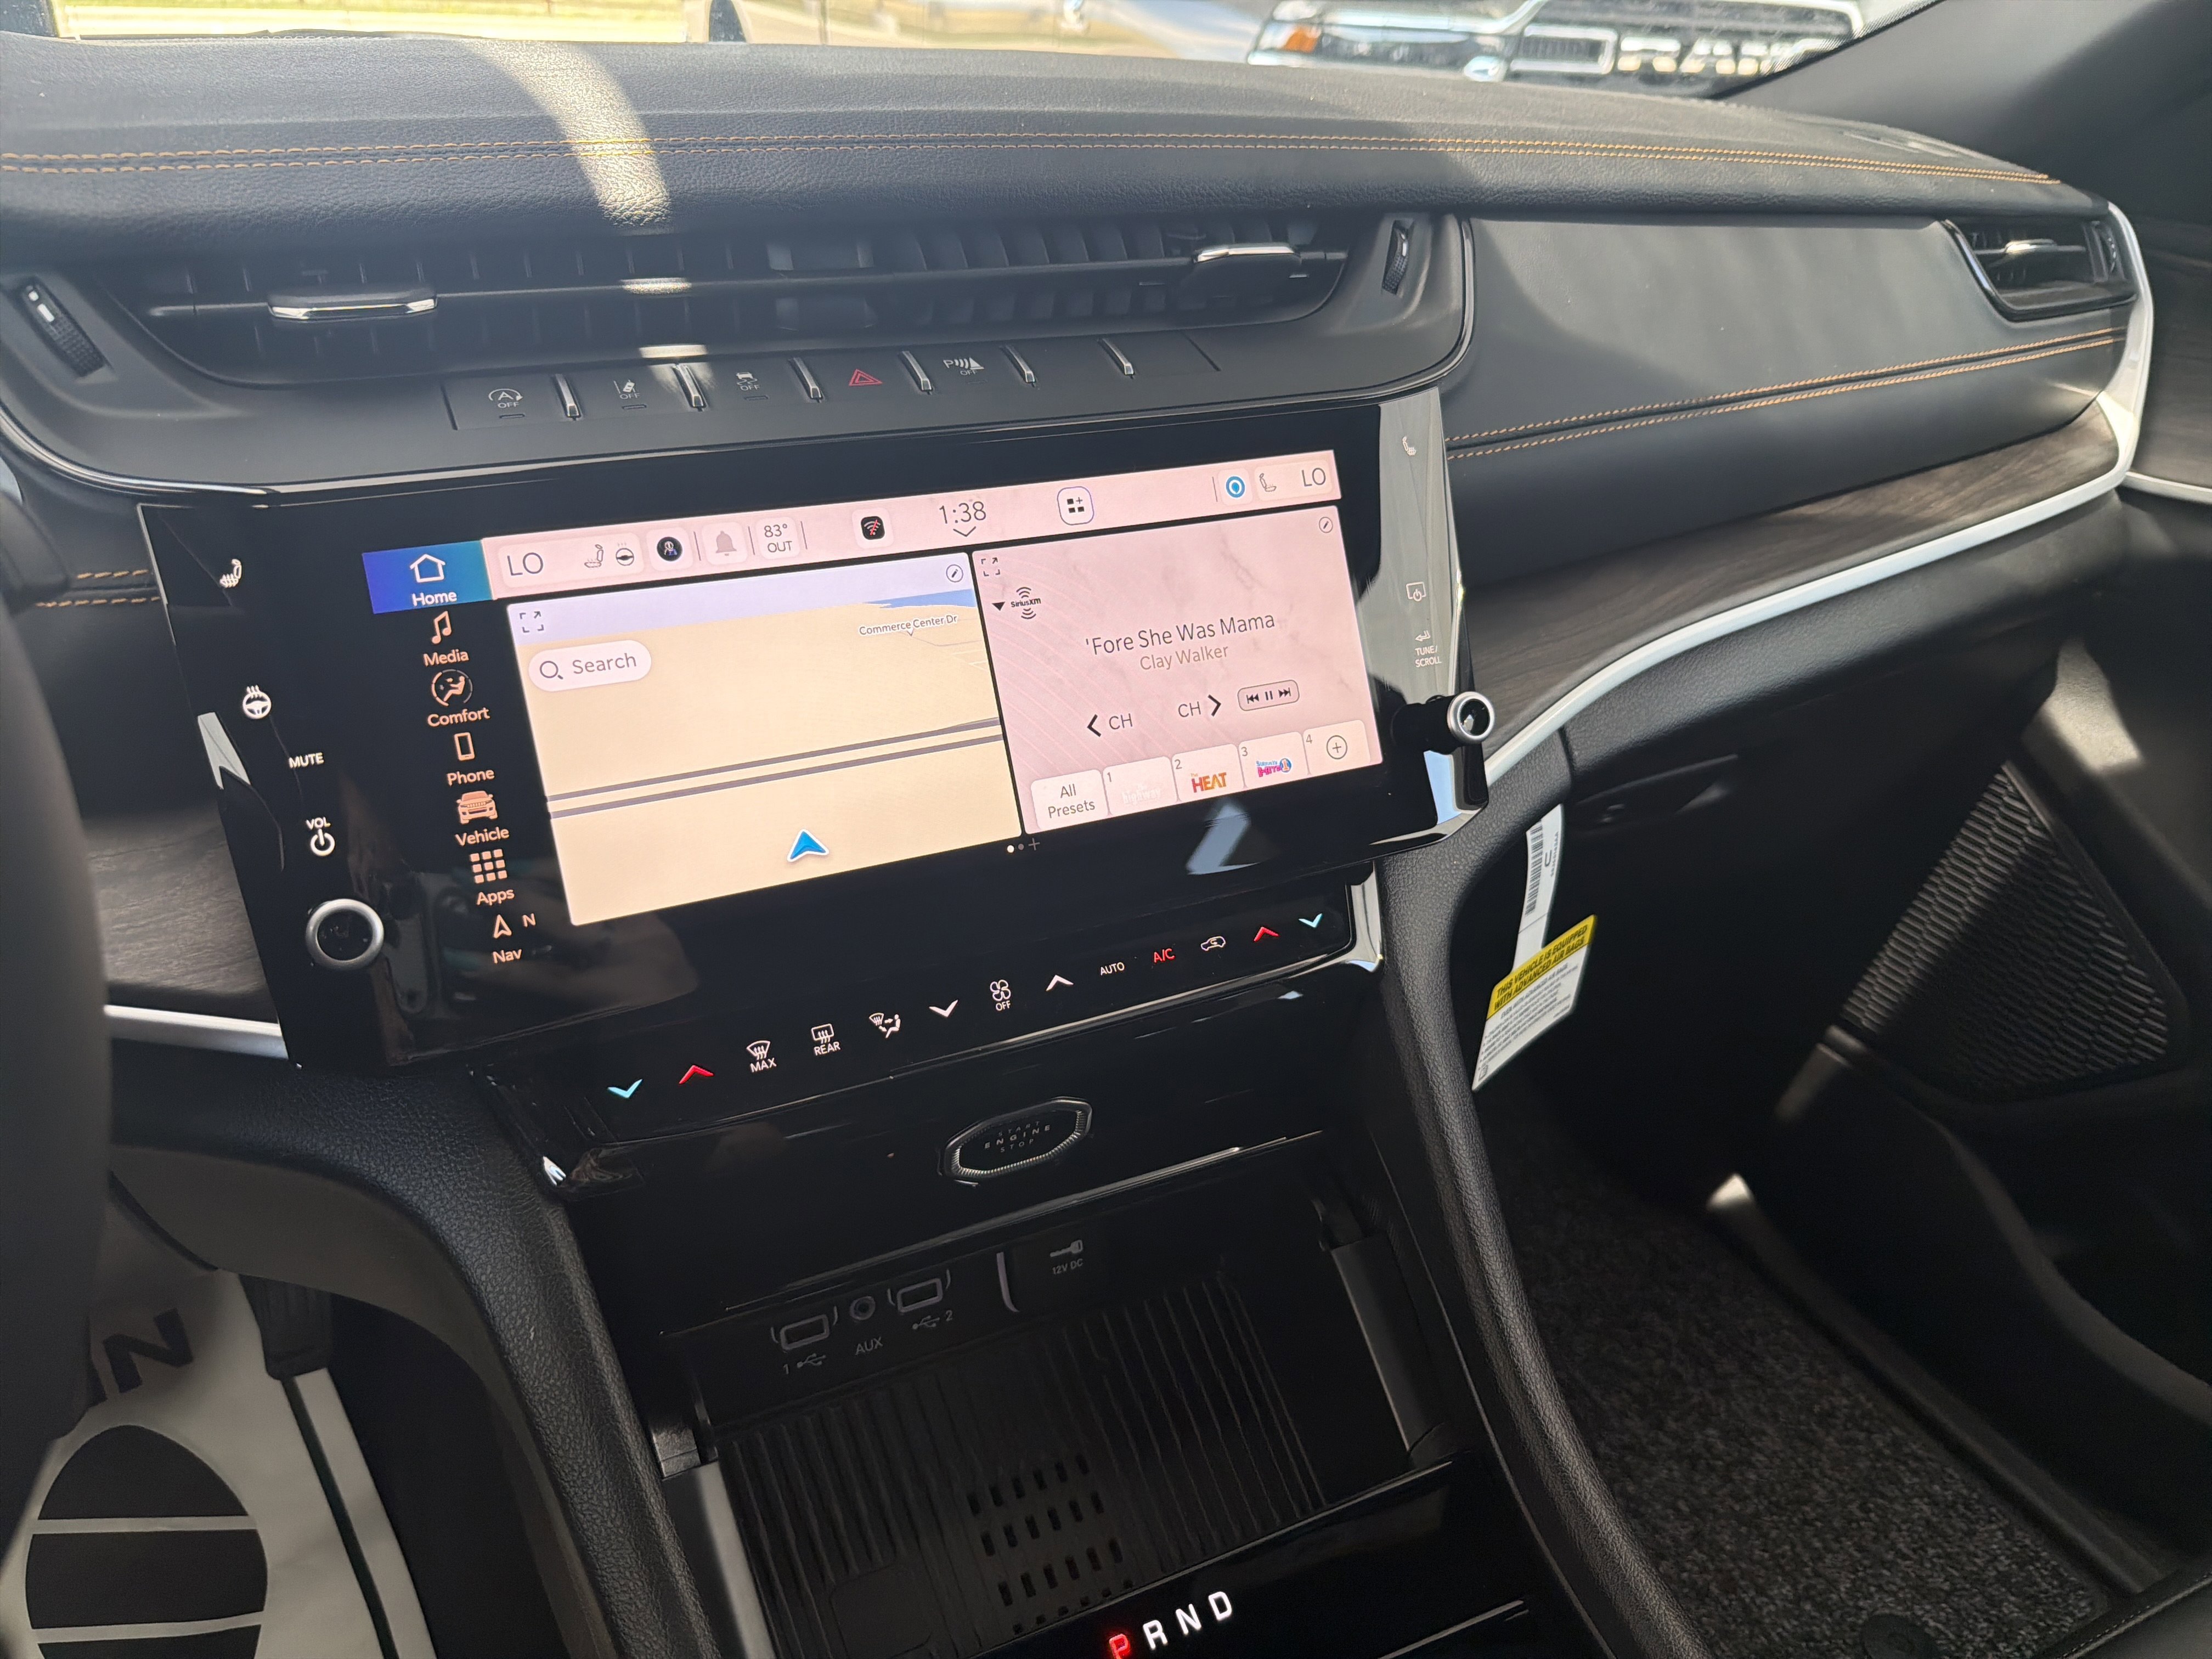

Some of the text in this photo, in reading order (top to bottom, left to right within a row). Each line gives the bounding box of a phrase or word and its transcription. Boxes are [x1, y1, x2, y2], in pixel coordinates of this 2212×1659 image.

[1301, 467, 1326, 488] LO
[939, 500, 987, 524] 1:38
[764, 524, 787, 538] 83°
[768, 540, 792, 554] OUT
[507, 552, 544, 576] LO
[412, 590, 457, 606] Home
[859, 613, 957, 635] Commerce Center Dr
[1137, 627, 1177, 648] She
[1180, 622, 1216, 641] Was
[1220, 613, 1276, 635] Mama
[424, 649, 470, 667] Media
[572, 653, 637, 675] Search
[1140, 644, 1228, 673] Clay Walker
[1415, 657, 1441, 668] SCROLL
[427, 707, 490, 727] Comfort
[1178, 702, 1201, 718] CH
[1109, 714, 1133, 730] CH
[1305, 734, 1313, 744] 4
[289, 752, 324, 768] MUTE
[1241, 747, 1248, 757] 3
[1175, 759, 1182, 770] 2
[447, 769, 495, 786] Phone
[1107, 772, 1112, 782] 1
[1192, 772, 1227, 793] HEAT
[1059, 783, 1077, 798] All
[1047, 800, 1096, 819] Presets
[306, 817, 331, 830] VOL
[455, 827, 510, 847] Vehicle
[476, 889, 515, 906] Apps
[522, 913, 537, 927] N
[493, 949, 522, 964] Nav
[1153, 948, 1176, 964] A/C
[1497, 924, 1588, 998] THIS VEHICLE IS EQUIPPED
[1100, 961, 1125, 976] AUTO
[1494, 936, 1584, 1011] WITH ADVANCED AIR BAGS
[995, 1001, 1011, 1012] OFF
[814, 1042, 841, 1056] REAR
[751, 1058, 777, 1073] MAX
[998, 1121, 1040, 1136] START
[985, 1125, 1051, 1149] ENGINE
[1001, 1138, 1034, 1153] STOP
[1052, 1259, 1084, 1276] 12V DC
[946, 1310, 953, 1322] 2
[855, 1336, 884, 1356] AUX
[783, 1364, 789, 1375] 1
[1109, 1591, 1232, 1659] P R N D
